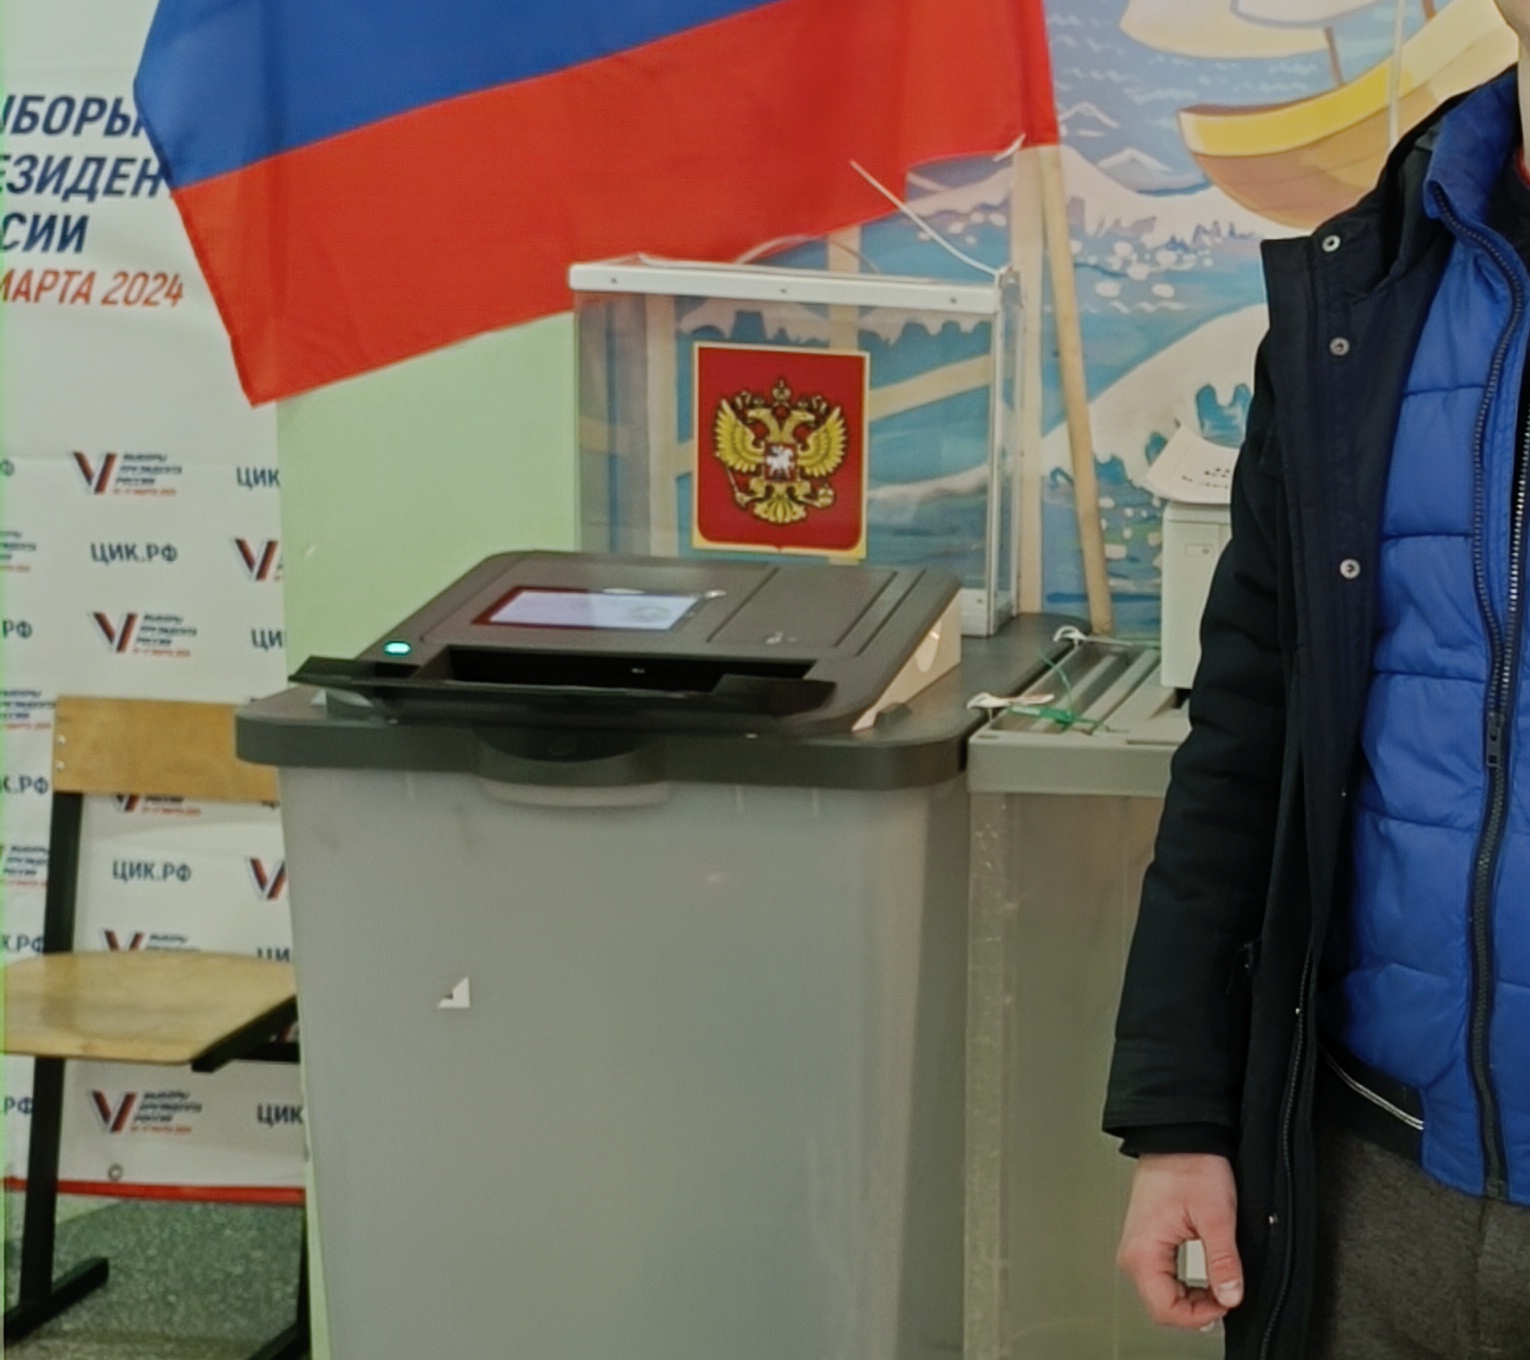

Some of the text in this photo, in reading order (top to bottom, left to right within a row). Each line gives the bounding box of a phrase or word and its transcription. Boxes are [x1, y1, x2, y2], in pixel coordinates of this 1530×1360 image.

[101, 270, 183, 308] 2024
[91, 542, 178, 566] ЦИК.РФ
[112, 859, 192, 883] ЦИК.РФ
